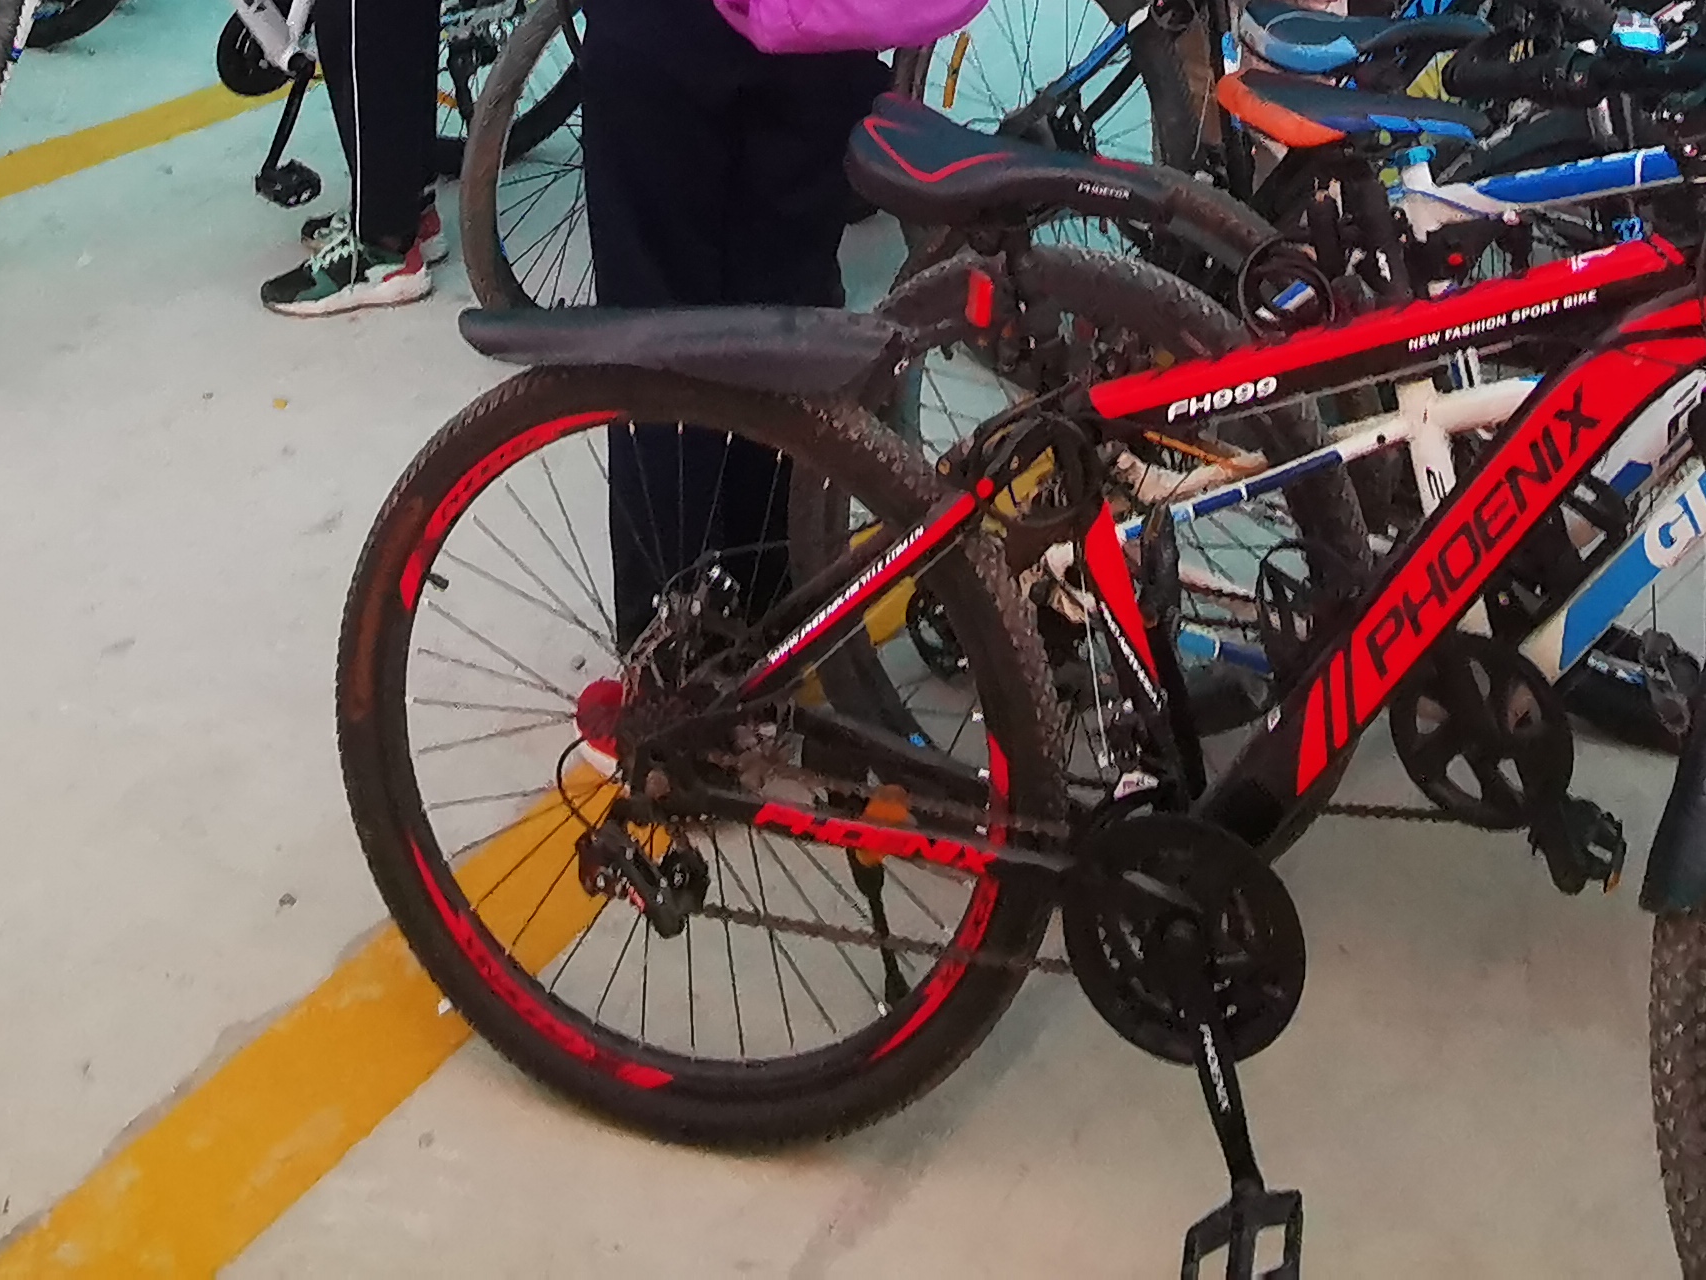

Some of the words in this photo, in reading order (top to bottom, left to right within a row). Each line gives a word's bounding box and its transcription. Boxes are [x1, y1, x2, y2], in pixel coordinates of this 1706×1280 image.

[1408, 331, 1441, 352] NEW
[1444, 313, 1507, 341] FASHION
[1511, 298, 1560, 325] SPORT
[1563, 289, 1598, 309] BIKE
[1365, 382, 1601, 681] PHOENIX
